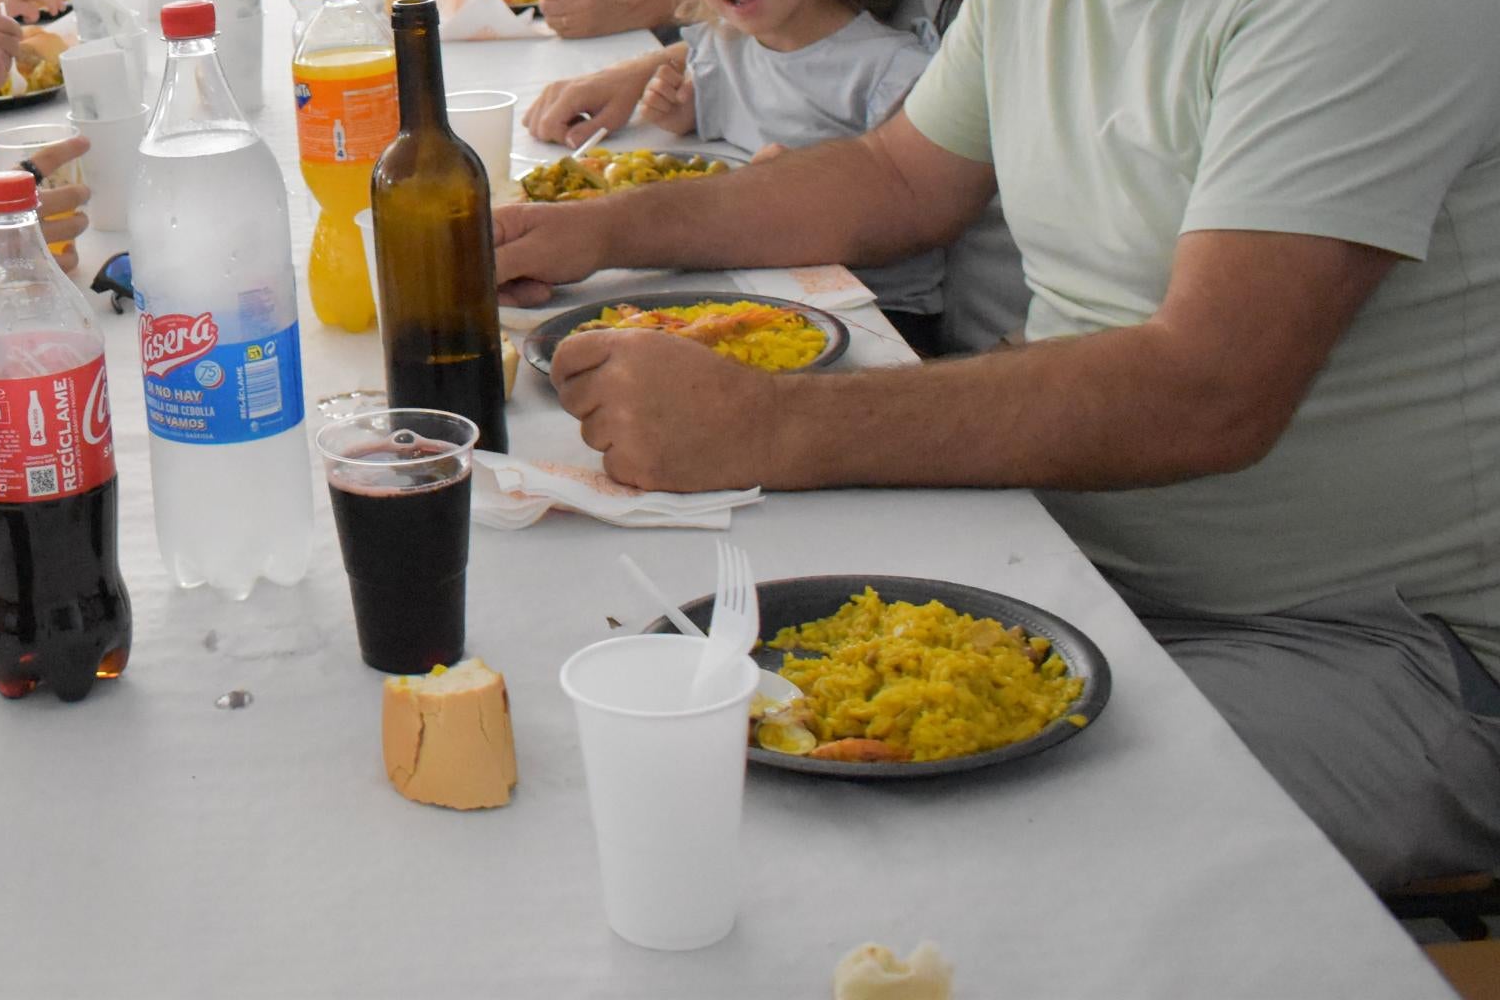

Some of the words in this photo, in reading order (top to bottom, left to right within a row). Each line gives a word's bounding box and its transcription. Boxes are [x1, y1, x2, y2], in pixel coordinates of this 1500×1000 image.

[175, 389, 203, 402] HAY
[165, 415, 207, 430] VAMOS
[53, 377, 77, 492] RECÍCLAME
